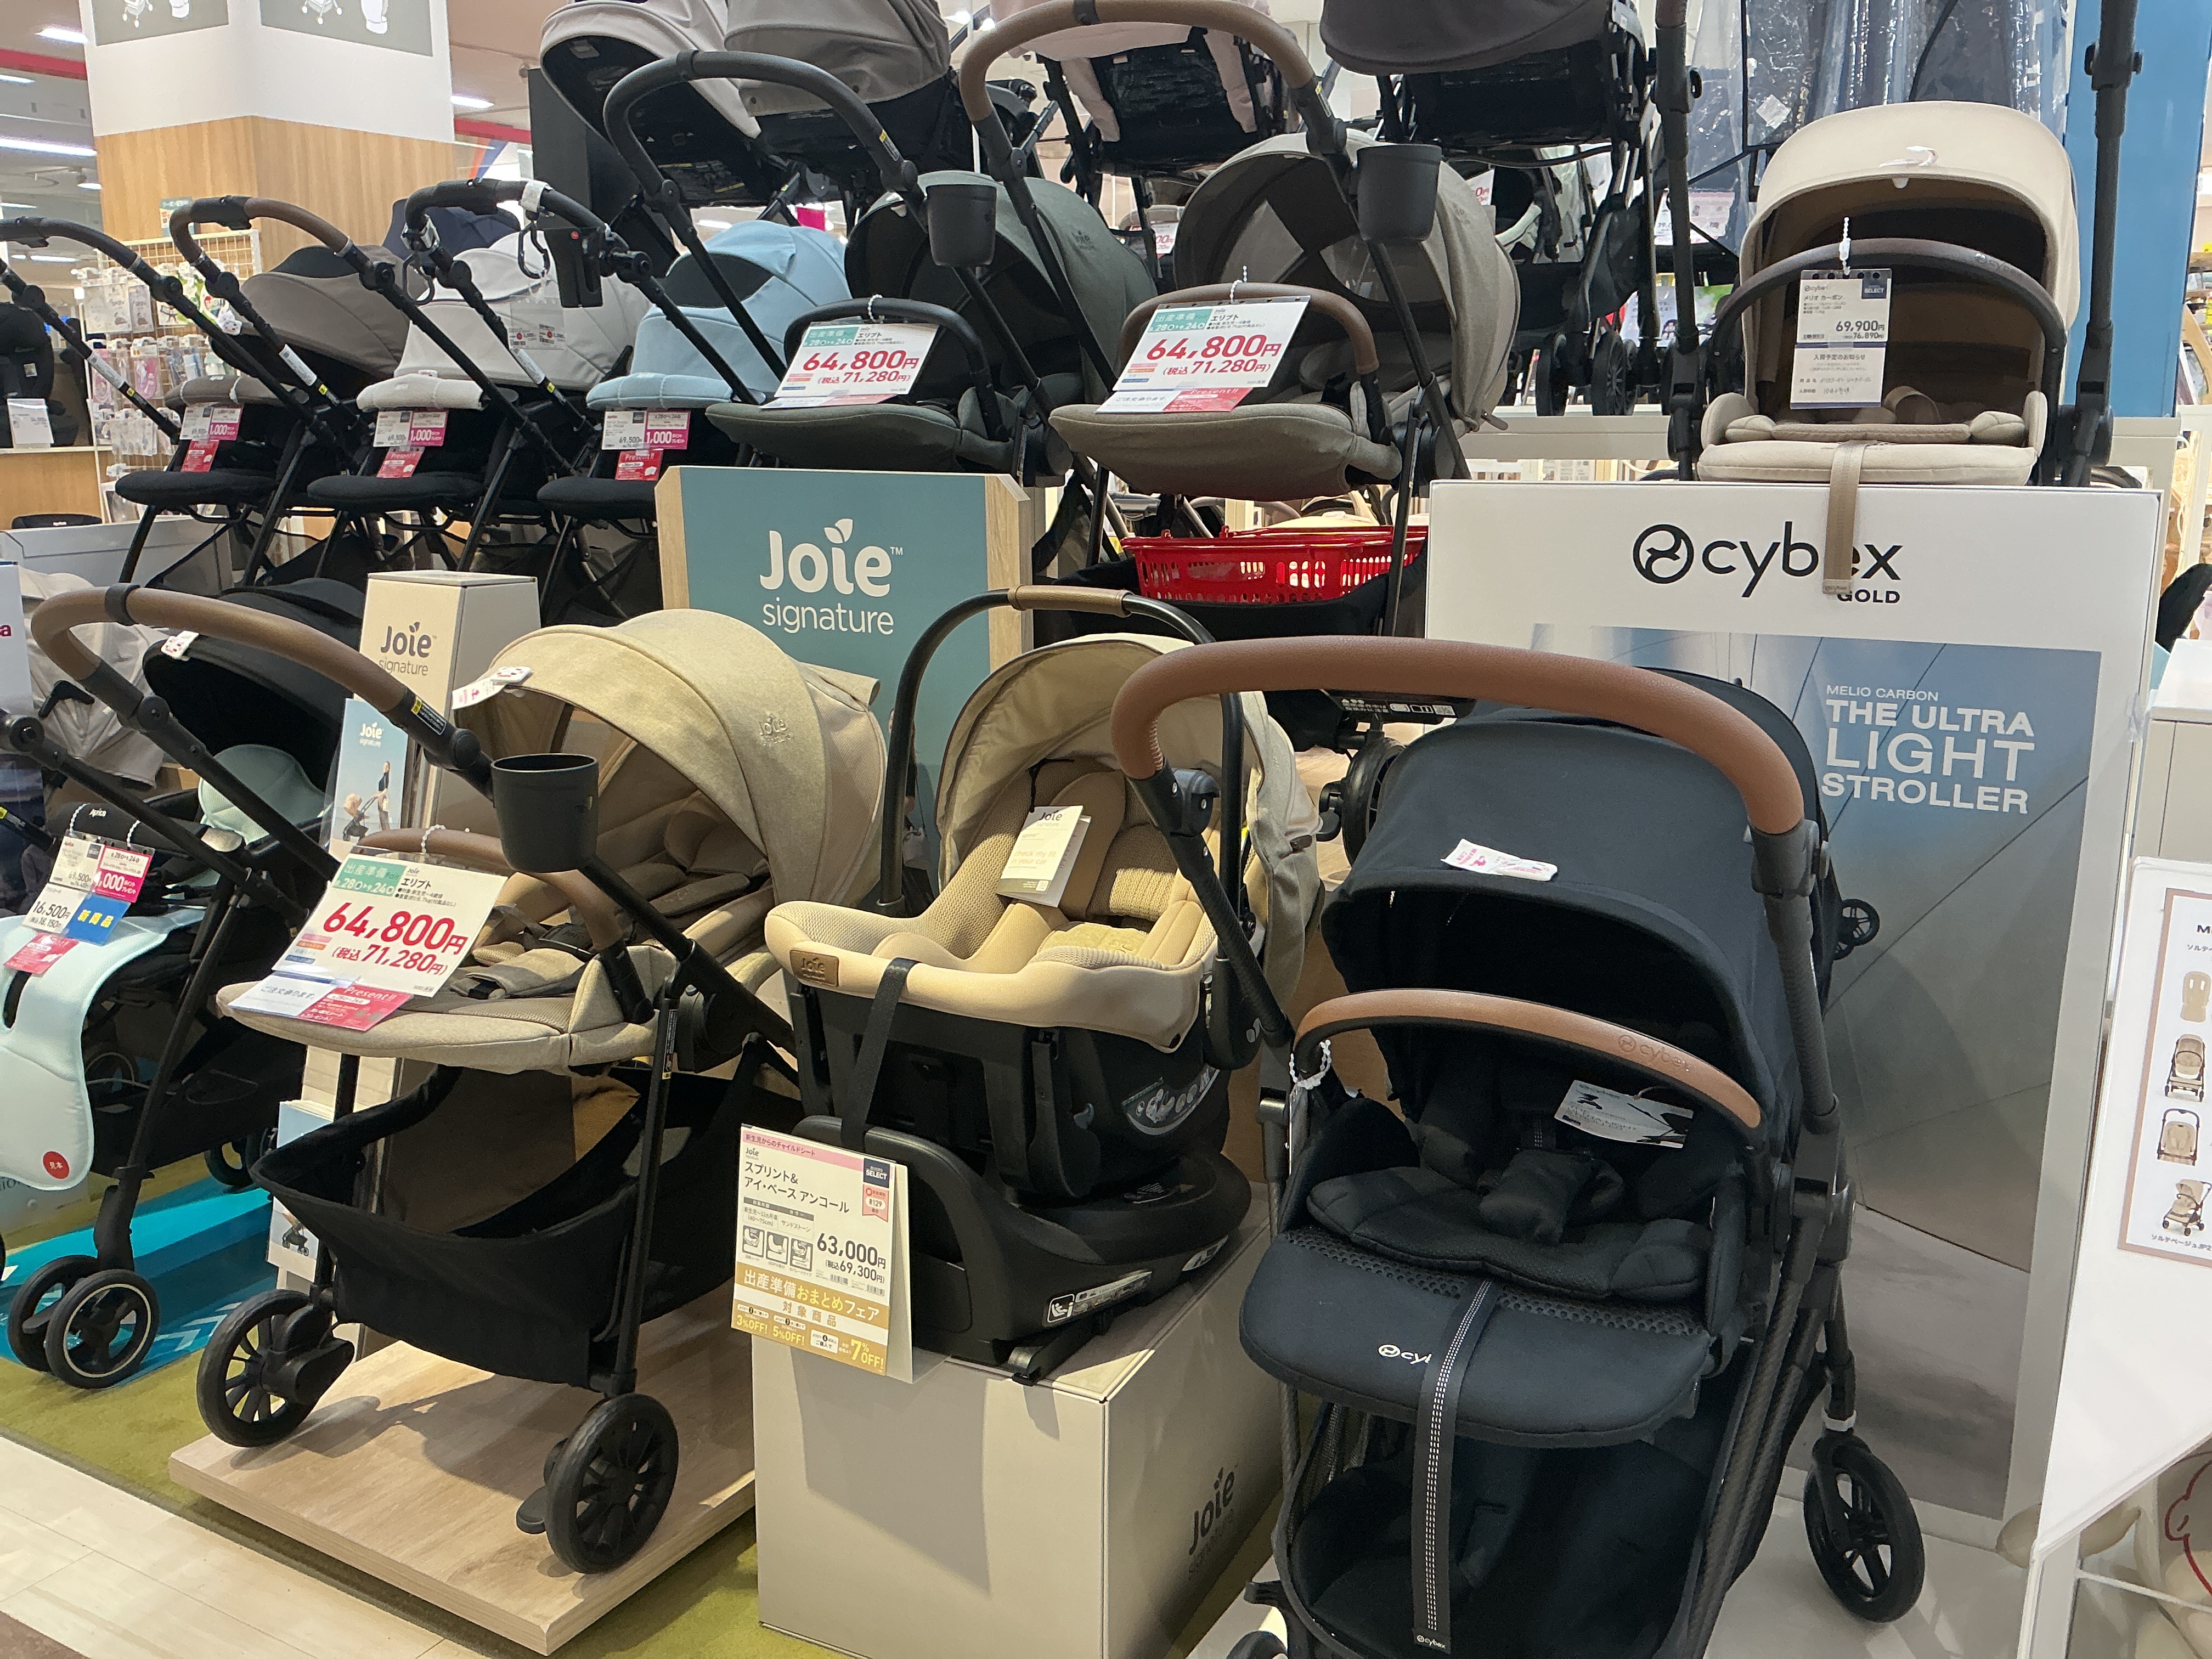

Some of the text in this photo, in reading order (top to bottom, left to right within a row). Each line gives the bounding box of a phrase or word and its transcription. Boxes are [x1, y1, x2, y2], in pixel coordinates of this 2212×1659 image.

[1836, 320, 1885, 332] 69,900円
[1146, 334, 1283, 360] 64,800円
[803, 349, 920, 371] 64,800円
[410, 429, 432, 442] 1,000
[646, 431, 672, 444] 1,000
[760, 518, 893, 597] Joie
[1702, 521, 1904, 597] cybx
[1836, 589, 1901, 604] GOLD
[763, 596, 894, 635] signature
[380, 621, 432, 658] Joie
[379, 657, 429, 676] signature
[1826, 685, 1939, 702] MELIO CARBON
[1825, 699, 2035, 737] THE ULTRA
[360, 722, 383, 739] Joie
[1826, 727, 2035, 782] LIGHT
[1821, 772, 2029, 815] STROLLER
[1039, 810, 1063, 821] Joie
[95, 871, 125, 891] ,000
[323, 901, 470, 956] 64,800円
[2197, 924, 2212, 934] M
[745, 1133, 816, 1157] 新生児からのチャイルドシート
[745, 1147, 759, 1157] Joie
[49, 1161, 64, 1170] 見本
[744, 1161, 799, 1184] スプリント&
[866, 1169, 888, 1180] SELECT
[800, 1190, 850, 1214] アンコール
[869, 1198, 882, 1207] R129
[781, 1220, 811, 1232] サンドストーン
[817, 1232, 887, 1269] 63,000円
[743, 1268, 880, 1321] 出産準備おまとめフェア
[736, 1314, 768, 1334] 3%OFF!
[782, 1300, 837, 1328] 対象商品
[772, 1325, 805, 1346] 5%OFF!
[1188, 1466, 1235, 1556] Joie
[1424, 1638, 1446, 1649] cybex
